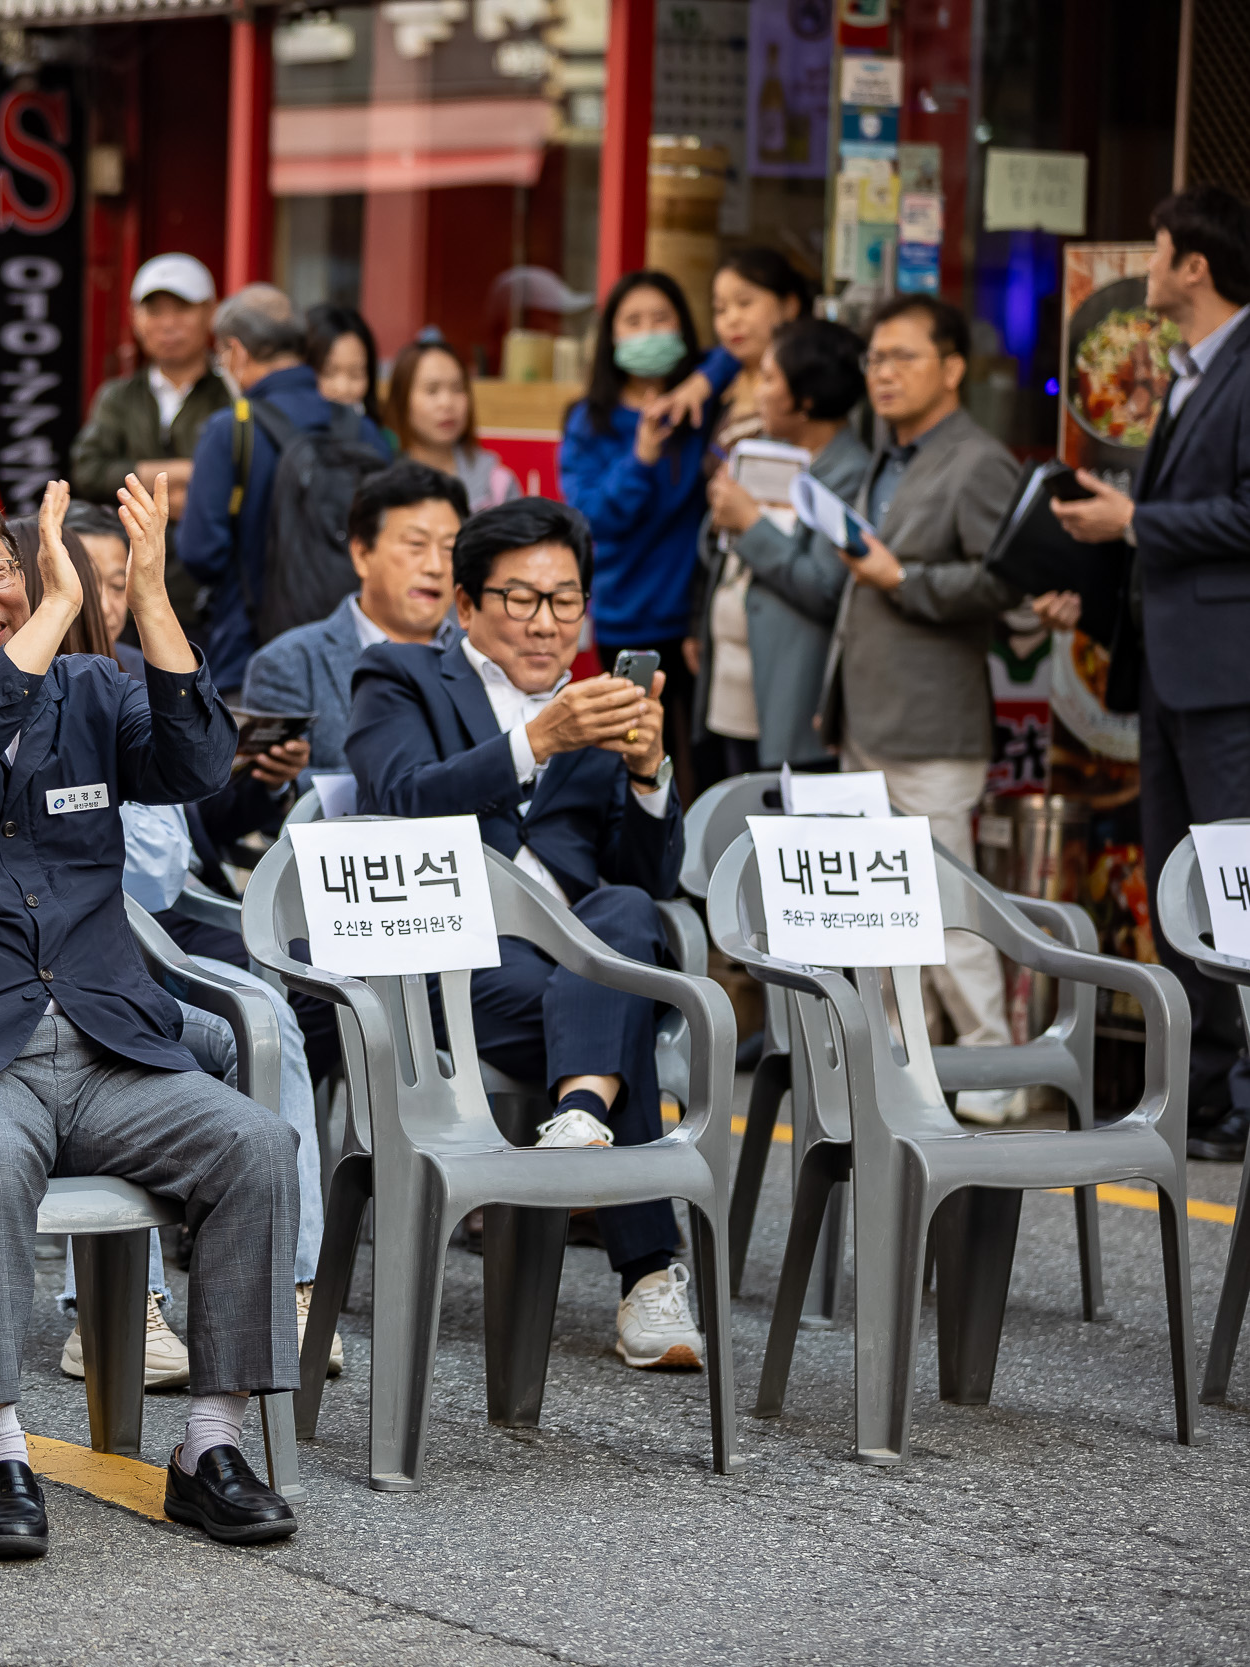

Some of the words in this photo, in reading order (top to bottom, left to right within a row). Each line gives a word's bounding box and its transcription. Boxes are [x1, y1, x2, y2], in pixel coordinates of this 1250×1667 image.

[320, 850, 461, 903] 내빈석
[778, 848, 910, 895] 내빈석
[333, 919, 373, 936] 오신환
[381, 915, 463, 936] 당협위원장
[820, 911, 884, 928] 광진구의회
[890, 910, 920, 928] 의장
